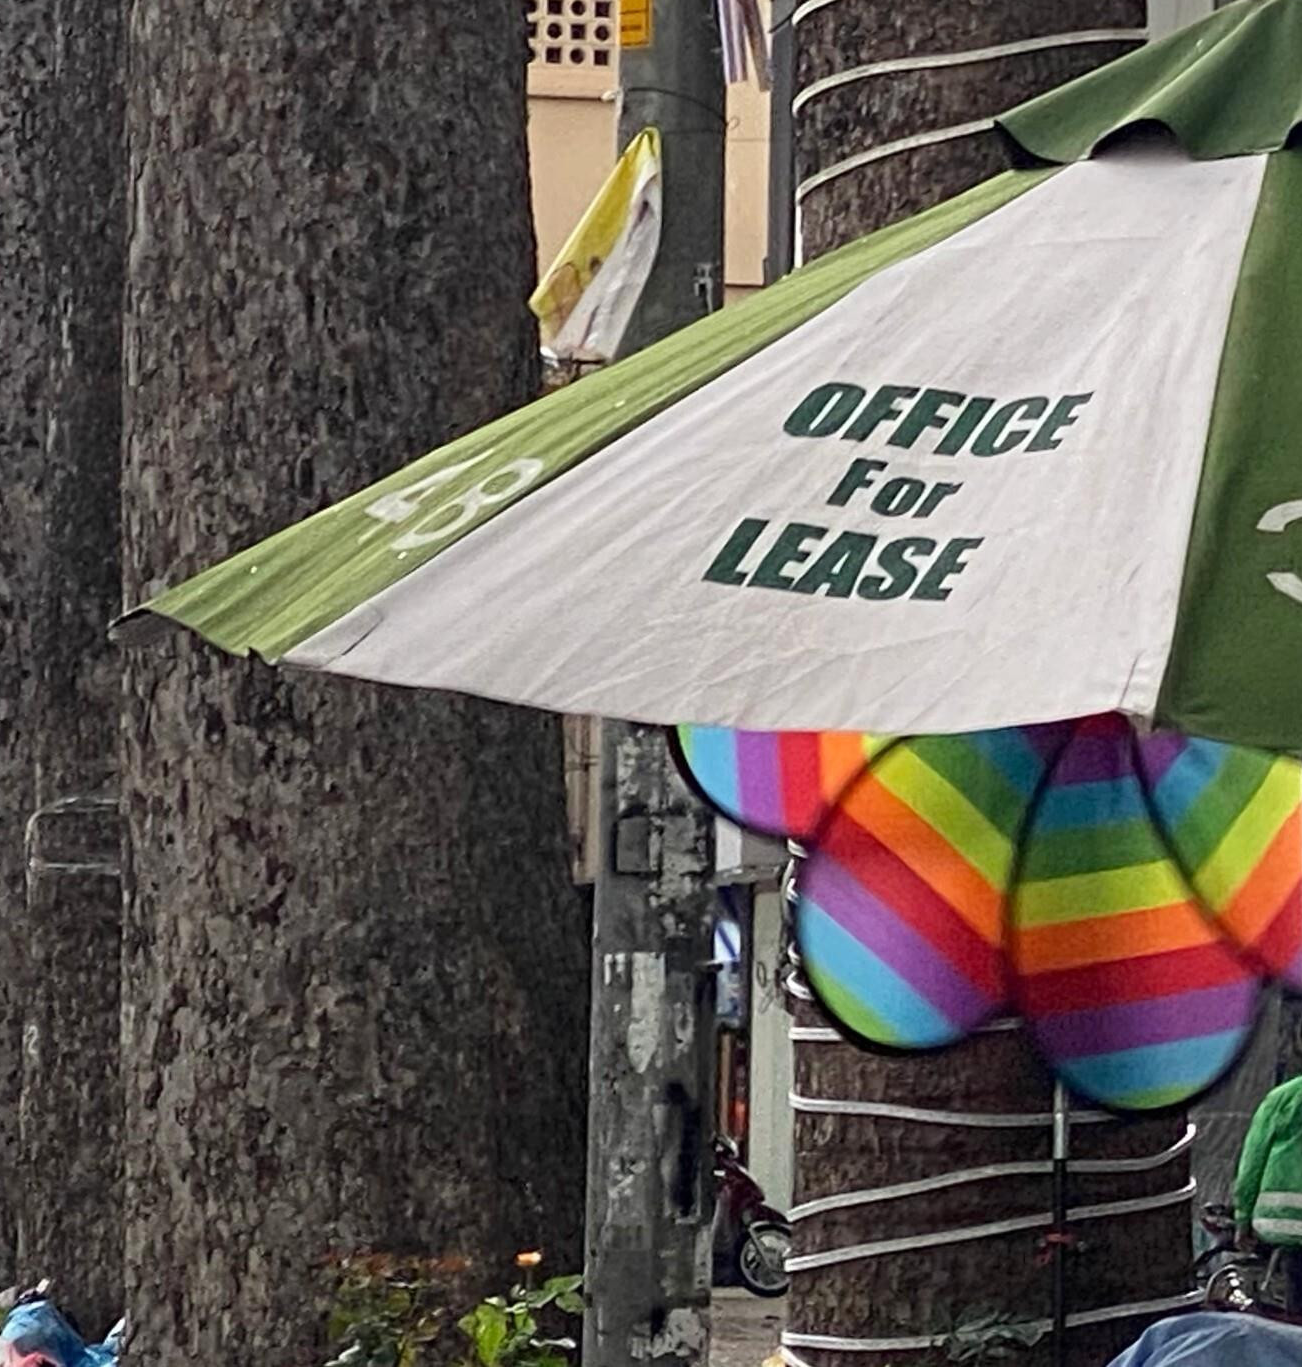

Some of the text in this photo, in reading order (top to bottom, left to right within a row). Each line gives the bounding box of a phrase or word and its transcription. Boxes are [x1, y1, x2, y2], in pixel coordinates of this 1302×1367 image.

[783, 382, 1096, 458] OFFICE
[826, 458, 964, 519] For
[700, 518, 986, 602] LEASE
